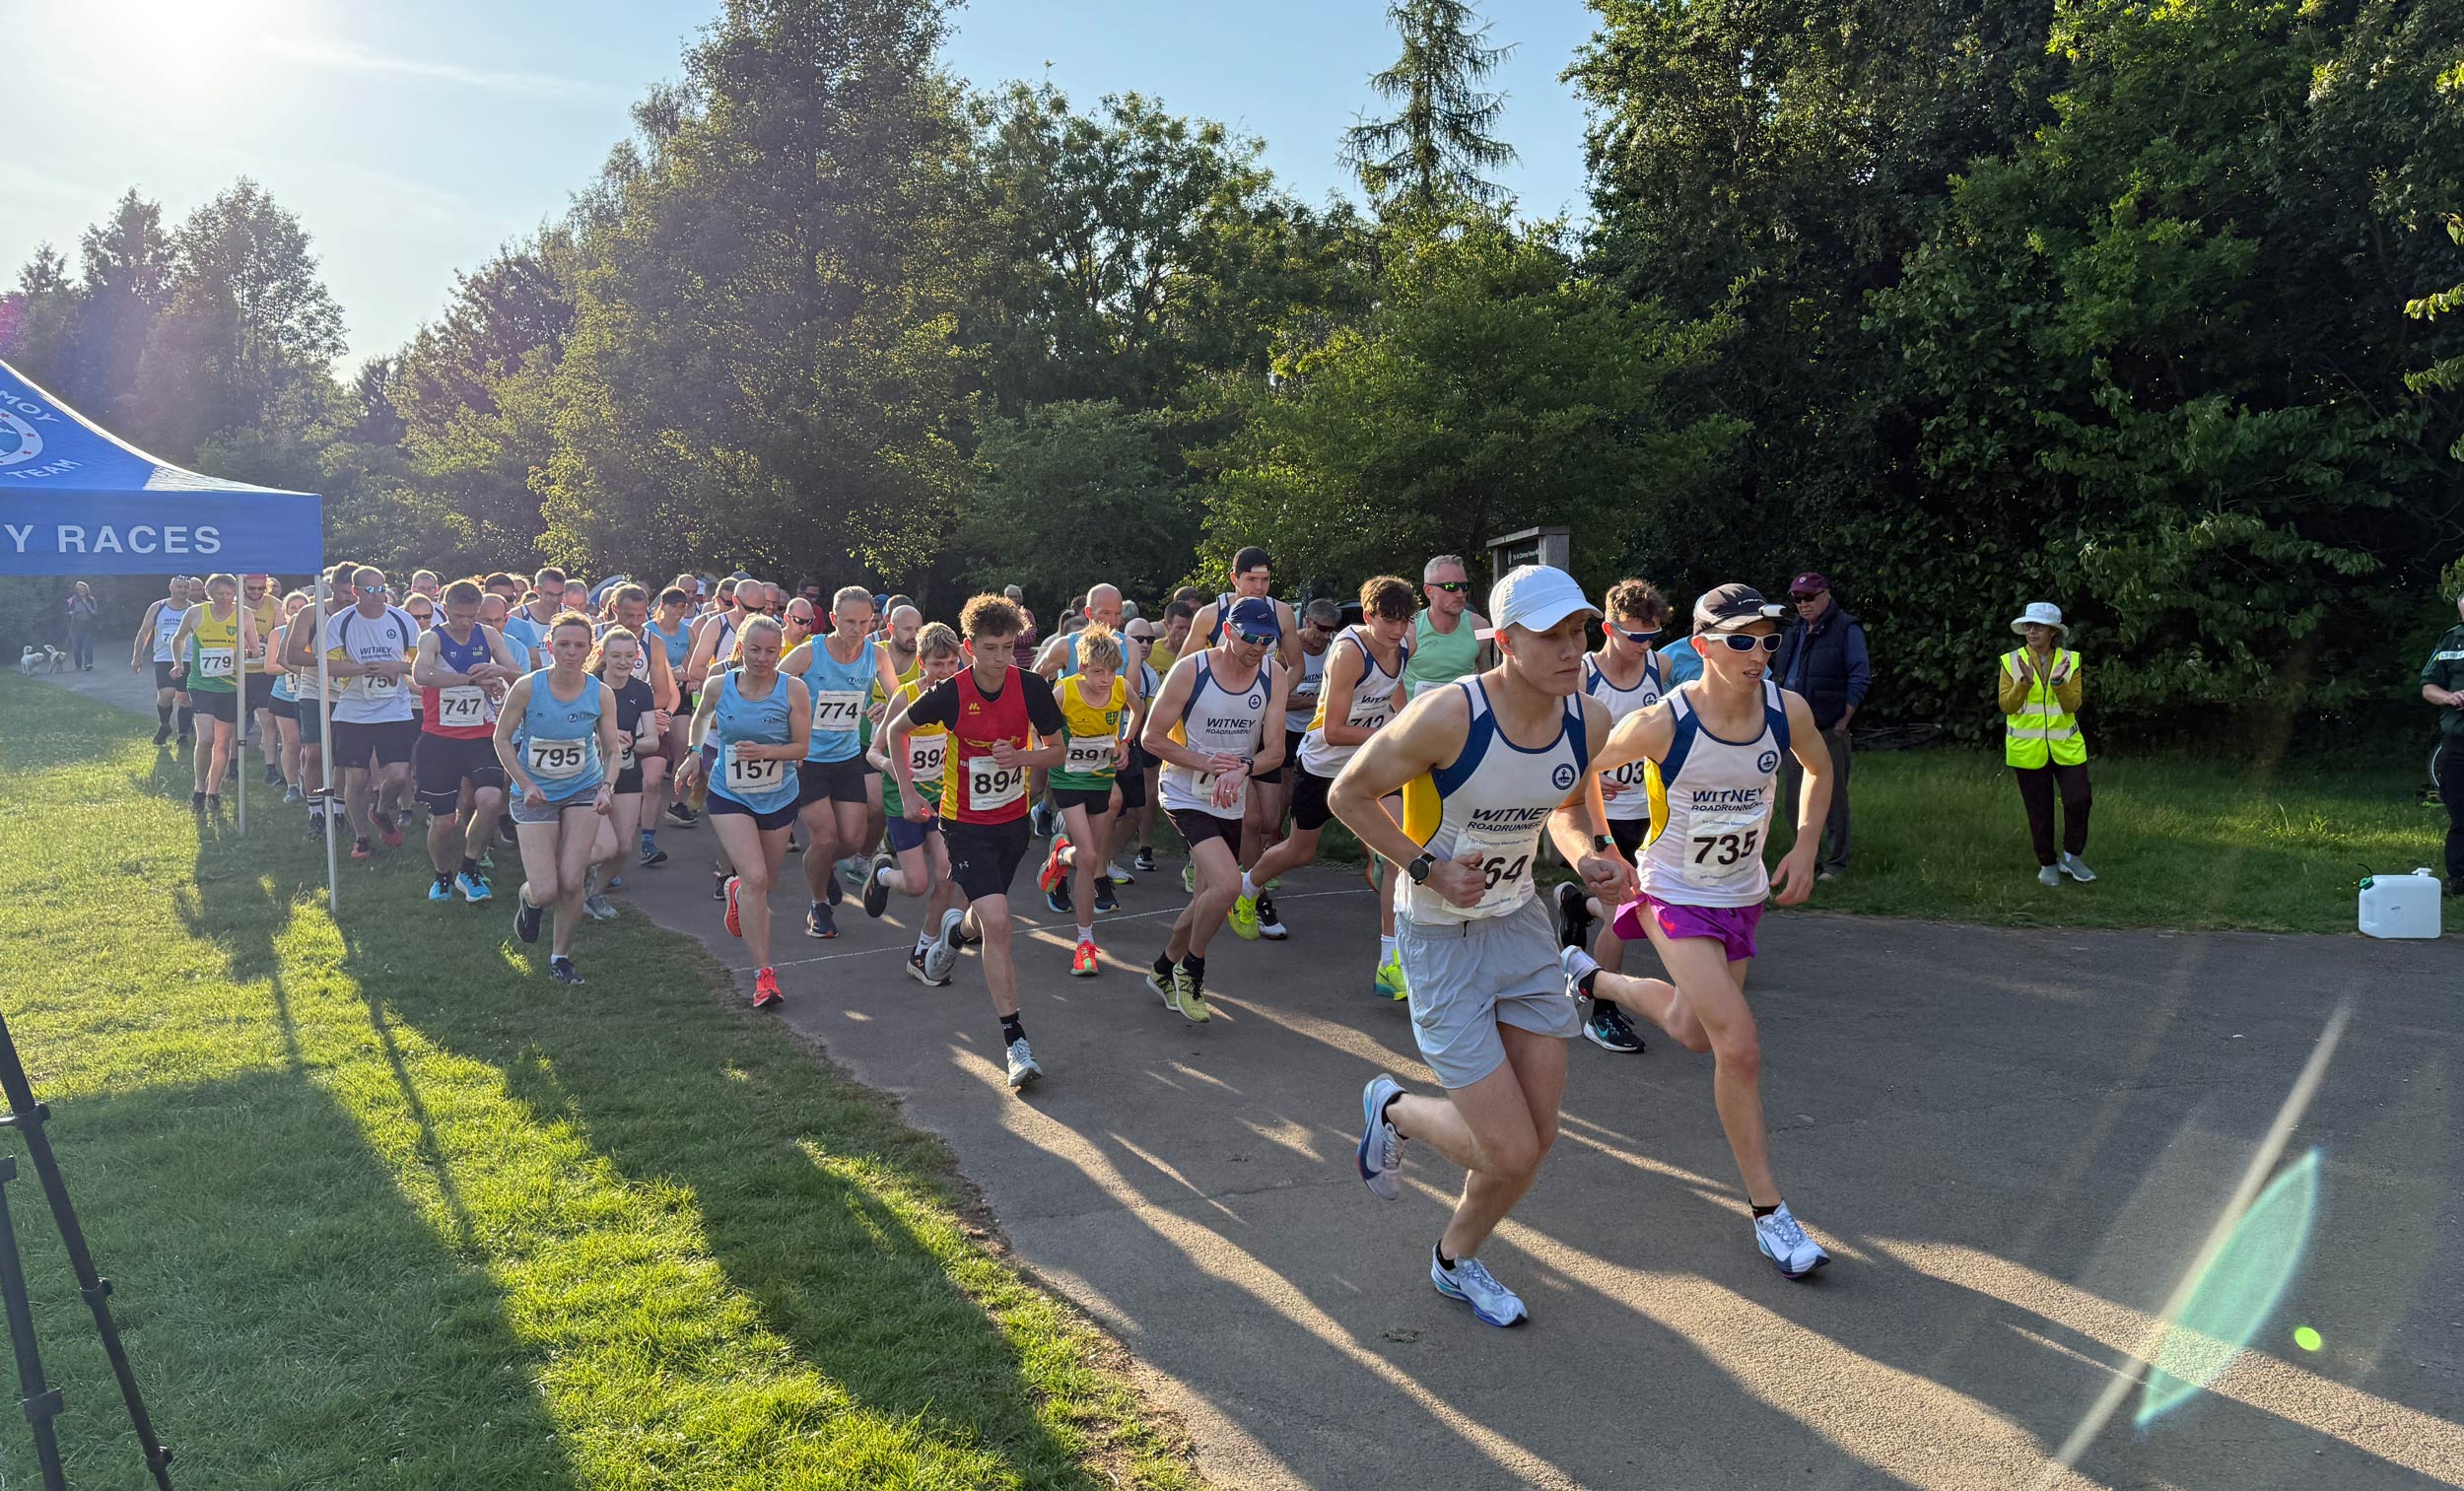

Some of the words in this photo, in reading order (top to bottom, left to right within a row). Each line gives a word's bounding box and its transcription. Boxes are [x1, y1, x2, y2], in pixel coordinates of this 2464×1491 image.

[5, 459, 83, 478] TEAM
[4, 524, 34, 553] Y
[56, 524, 221, 554] RACES
[360, 645, 392, 655] WITNEY
[201, 656, 232, 669] 779
[364, 674, 389, 689] 75
[443, 698, 481, 715] 747
[819, 703, 857, 719] 774
[1206, 717, 1256, 728] WITNEY
[532, 748, 581, 768] 795
[1069, 747, 1110, 761] 891
[730, 760, 779, 779] 157
[1603, 761, 1645, 784] 03
[974, 766, 1022, 795] 894
[1692, 785, 1767, 803] WITNEY
[1693, 829, 1758, 865] 735
[1474, 854, 1530, 890] 64
